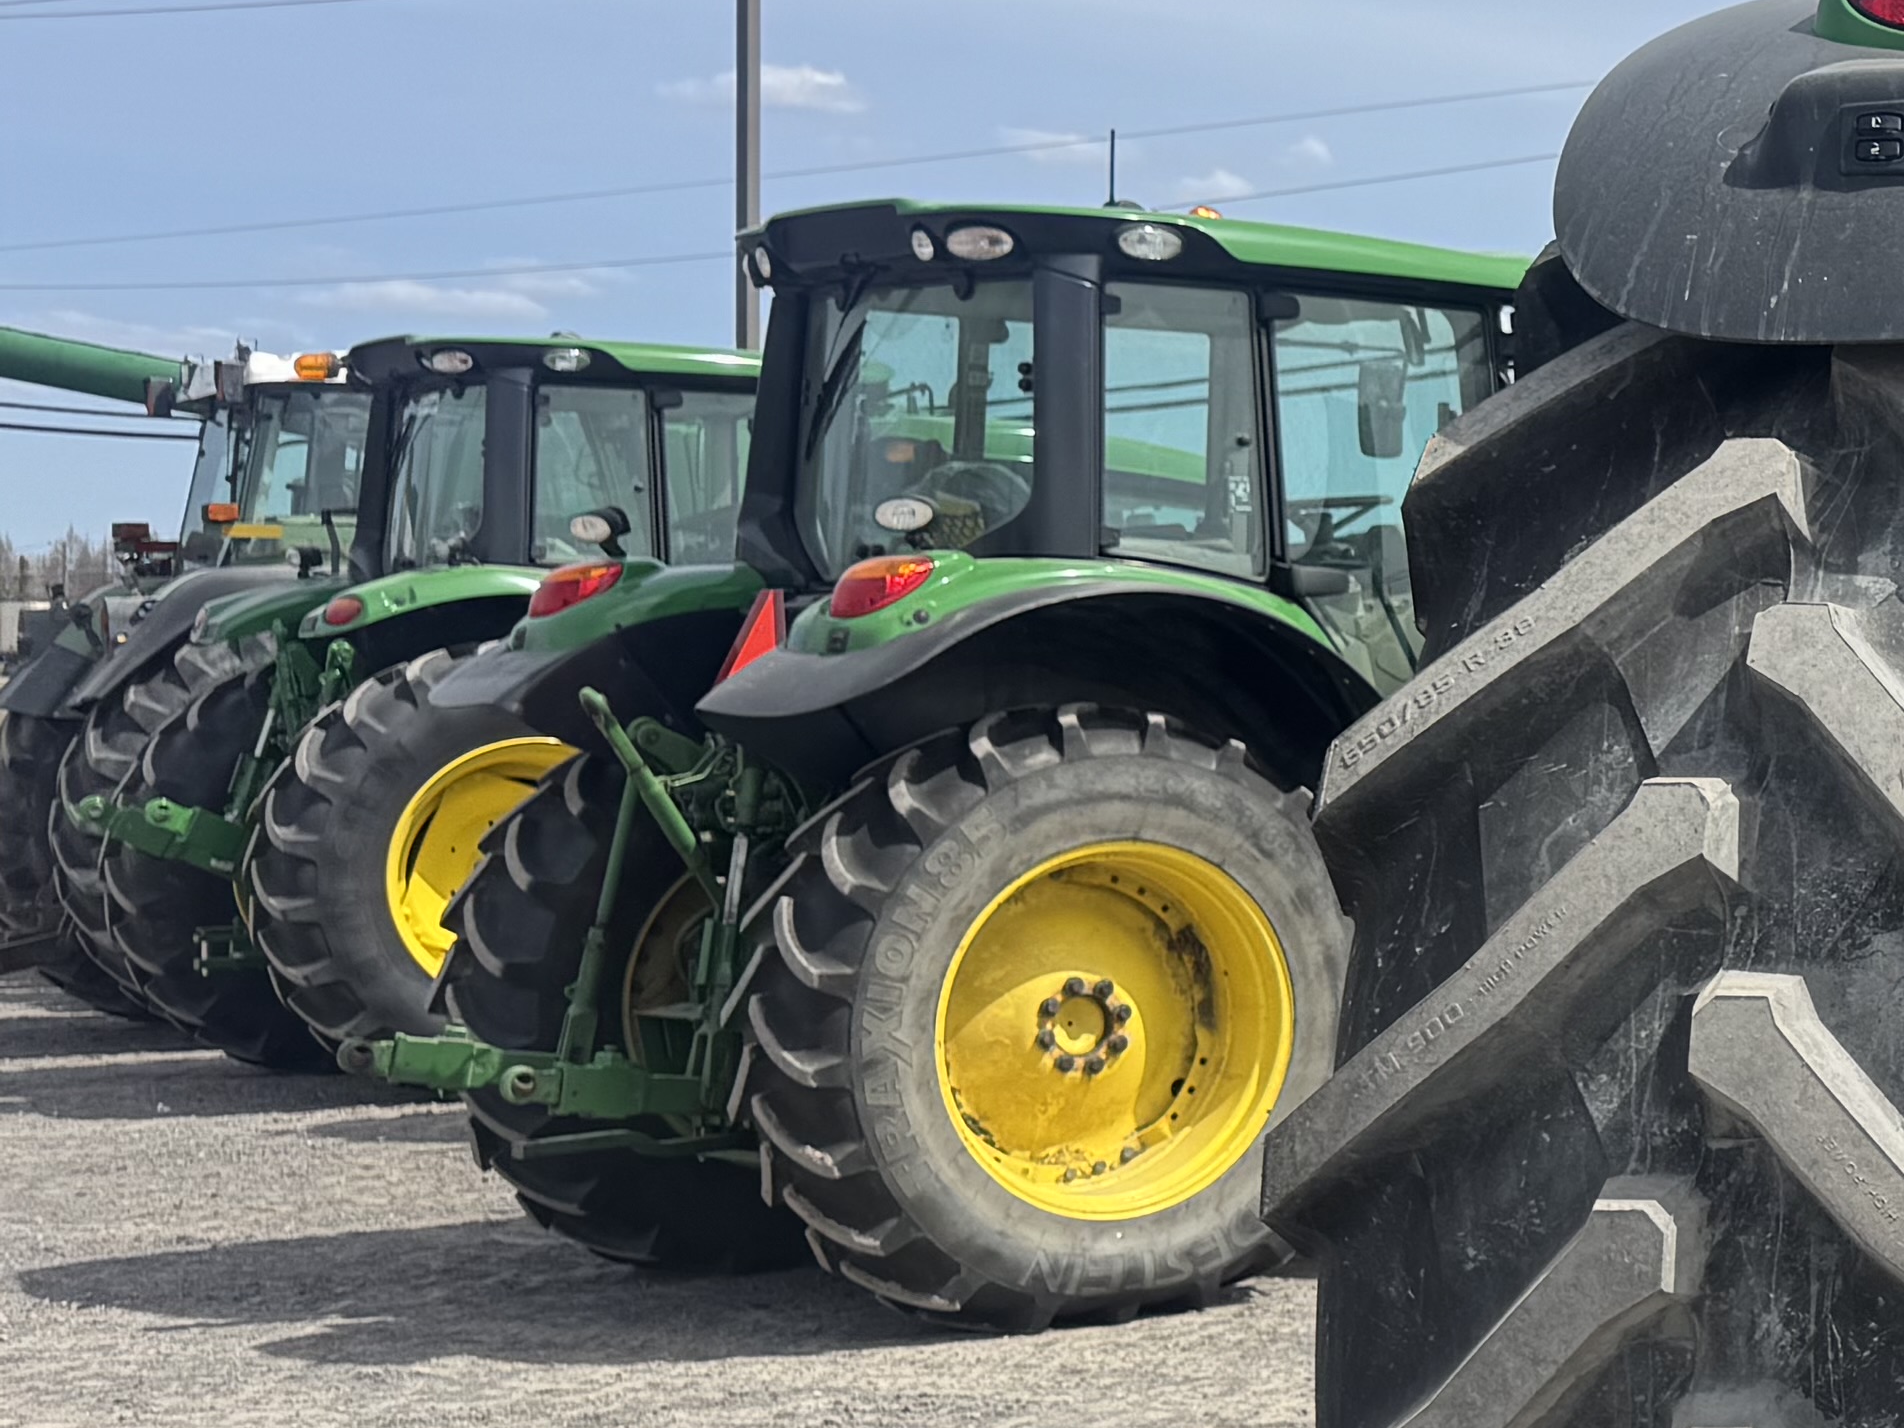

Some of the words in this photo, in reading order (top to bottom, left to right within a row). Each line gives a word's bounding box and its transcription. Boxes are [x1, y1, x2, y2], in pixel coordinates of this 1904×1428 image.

[923, 807, 1008, 890] 85
[1407, 1001, 1464, 1053] 900
[1019, 1208, 1270, 1295] DESTEIN
